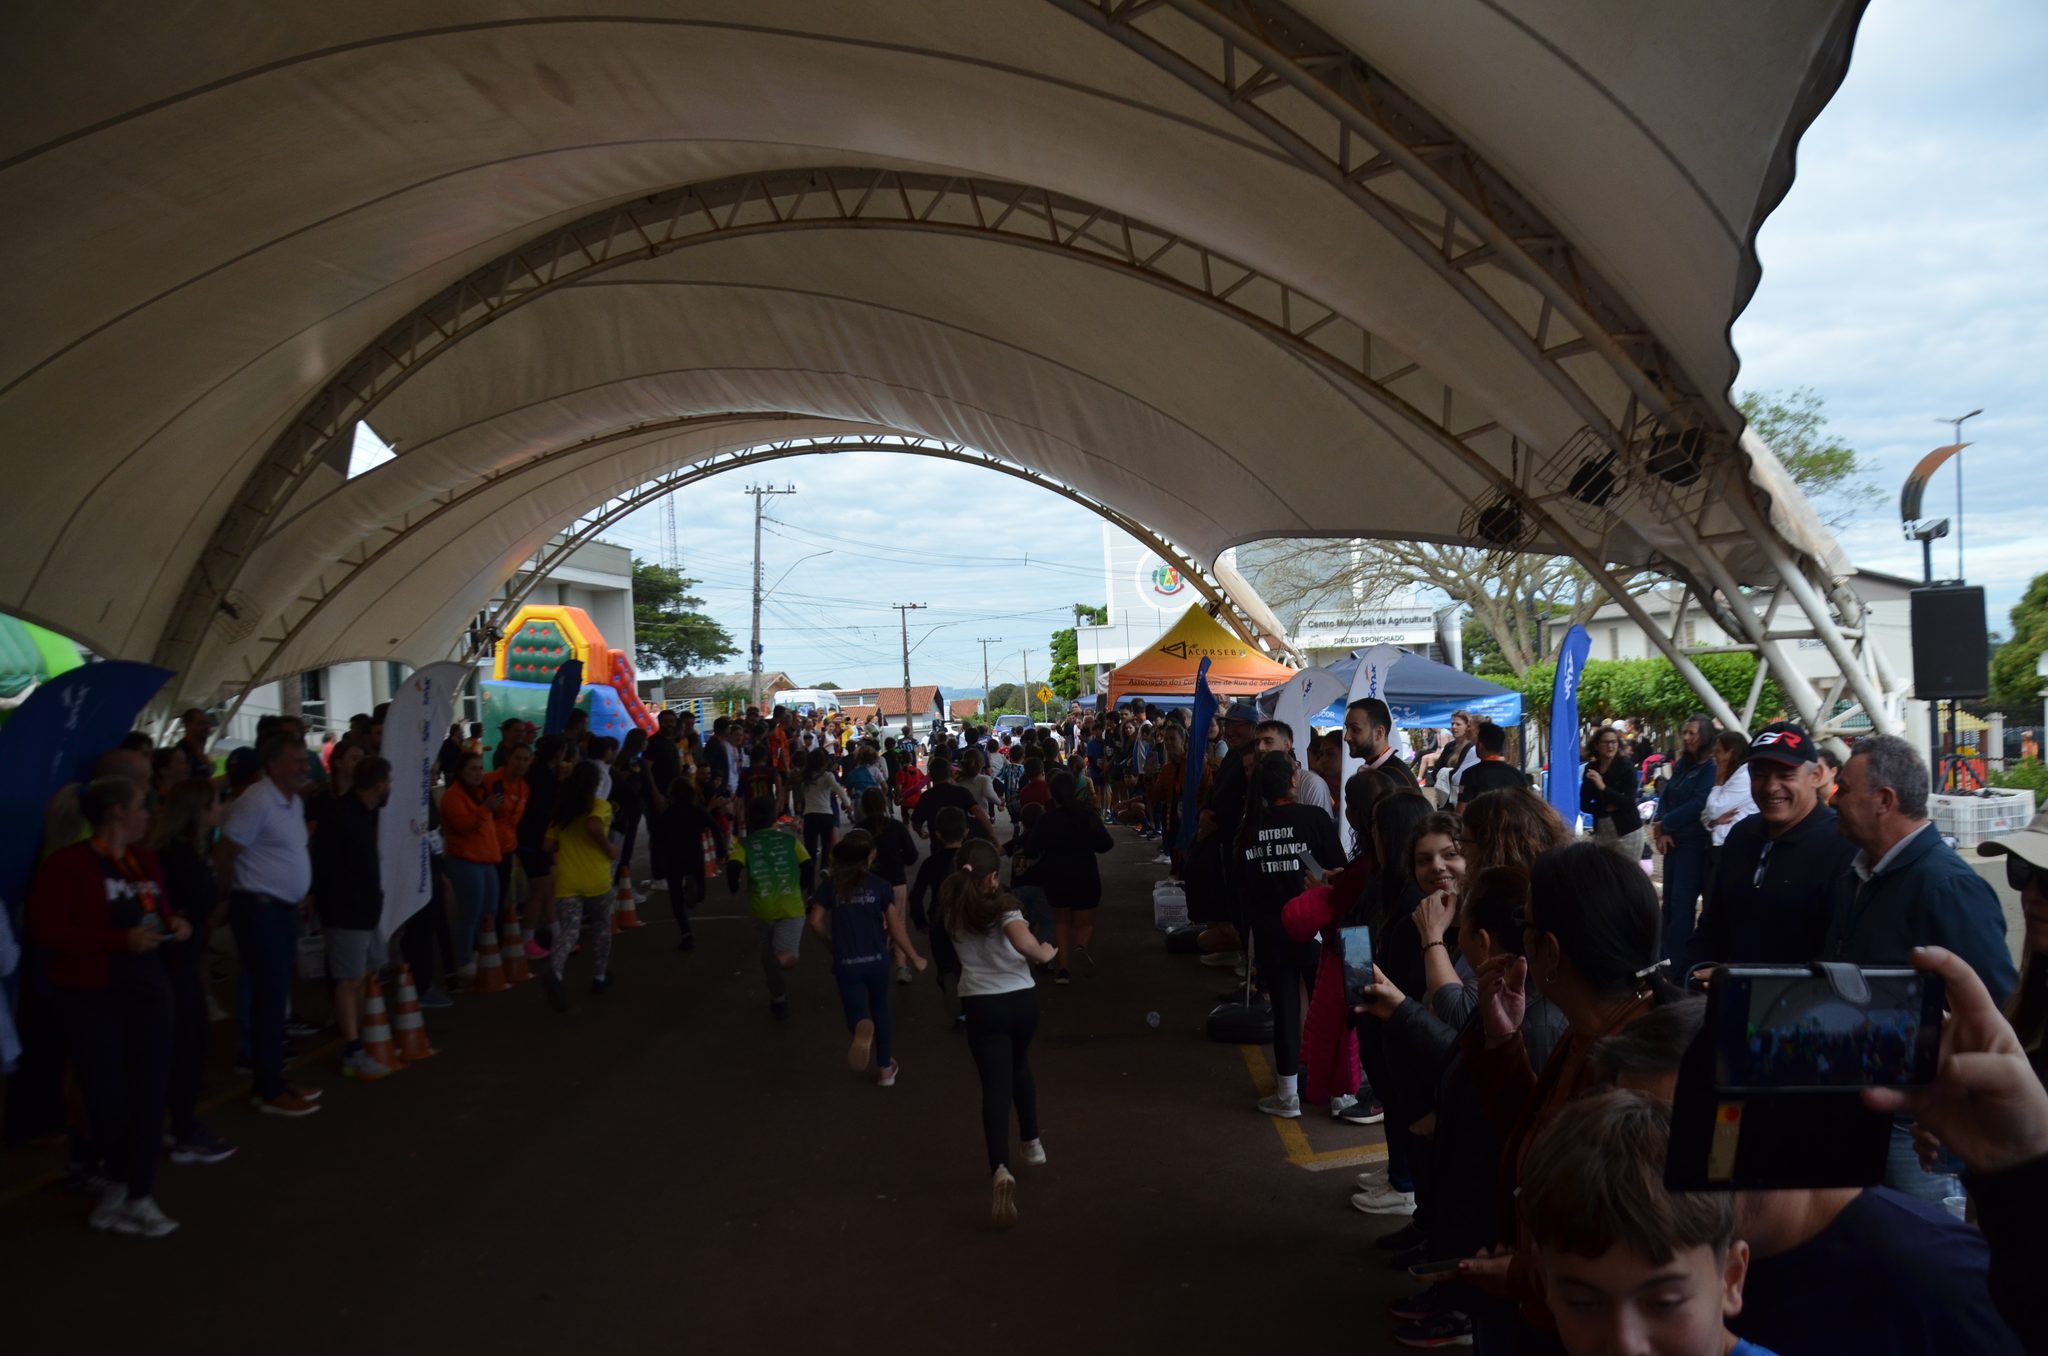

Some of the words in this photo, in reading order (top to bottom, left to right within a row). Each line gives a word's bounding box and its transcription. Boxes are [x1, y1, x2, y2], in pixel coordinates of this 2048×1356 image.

[1308, 620, 1335, 628] Centro
[1336, 618, 1375, 627] Municipal
[1388, 615, 1432, 626] Agricultura
[1361, 634, 1405, 643] SPONCHIADO
[1188, 648, 1237, 656] ACORSEB
[1128, 678, 1168, 687] Associação
[1223, 678, 1232, 686] de
[1233, 678, 1248, 686] Rua
[1249, 679, 1259, 687] de
[1751, 731, 1803, 749] GR
[1258, 826, 1294, 841] RITBOX
[1245, 846, 1264, 860] NÃO
[1266, 842, 1273, 856] É
